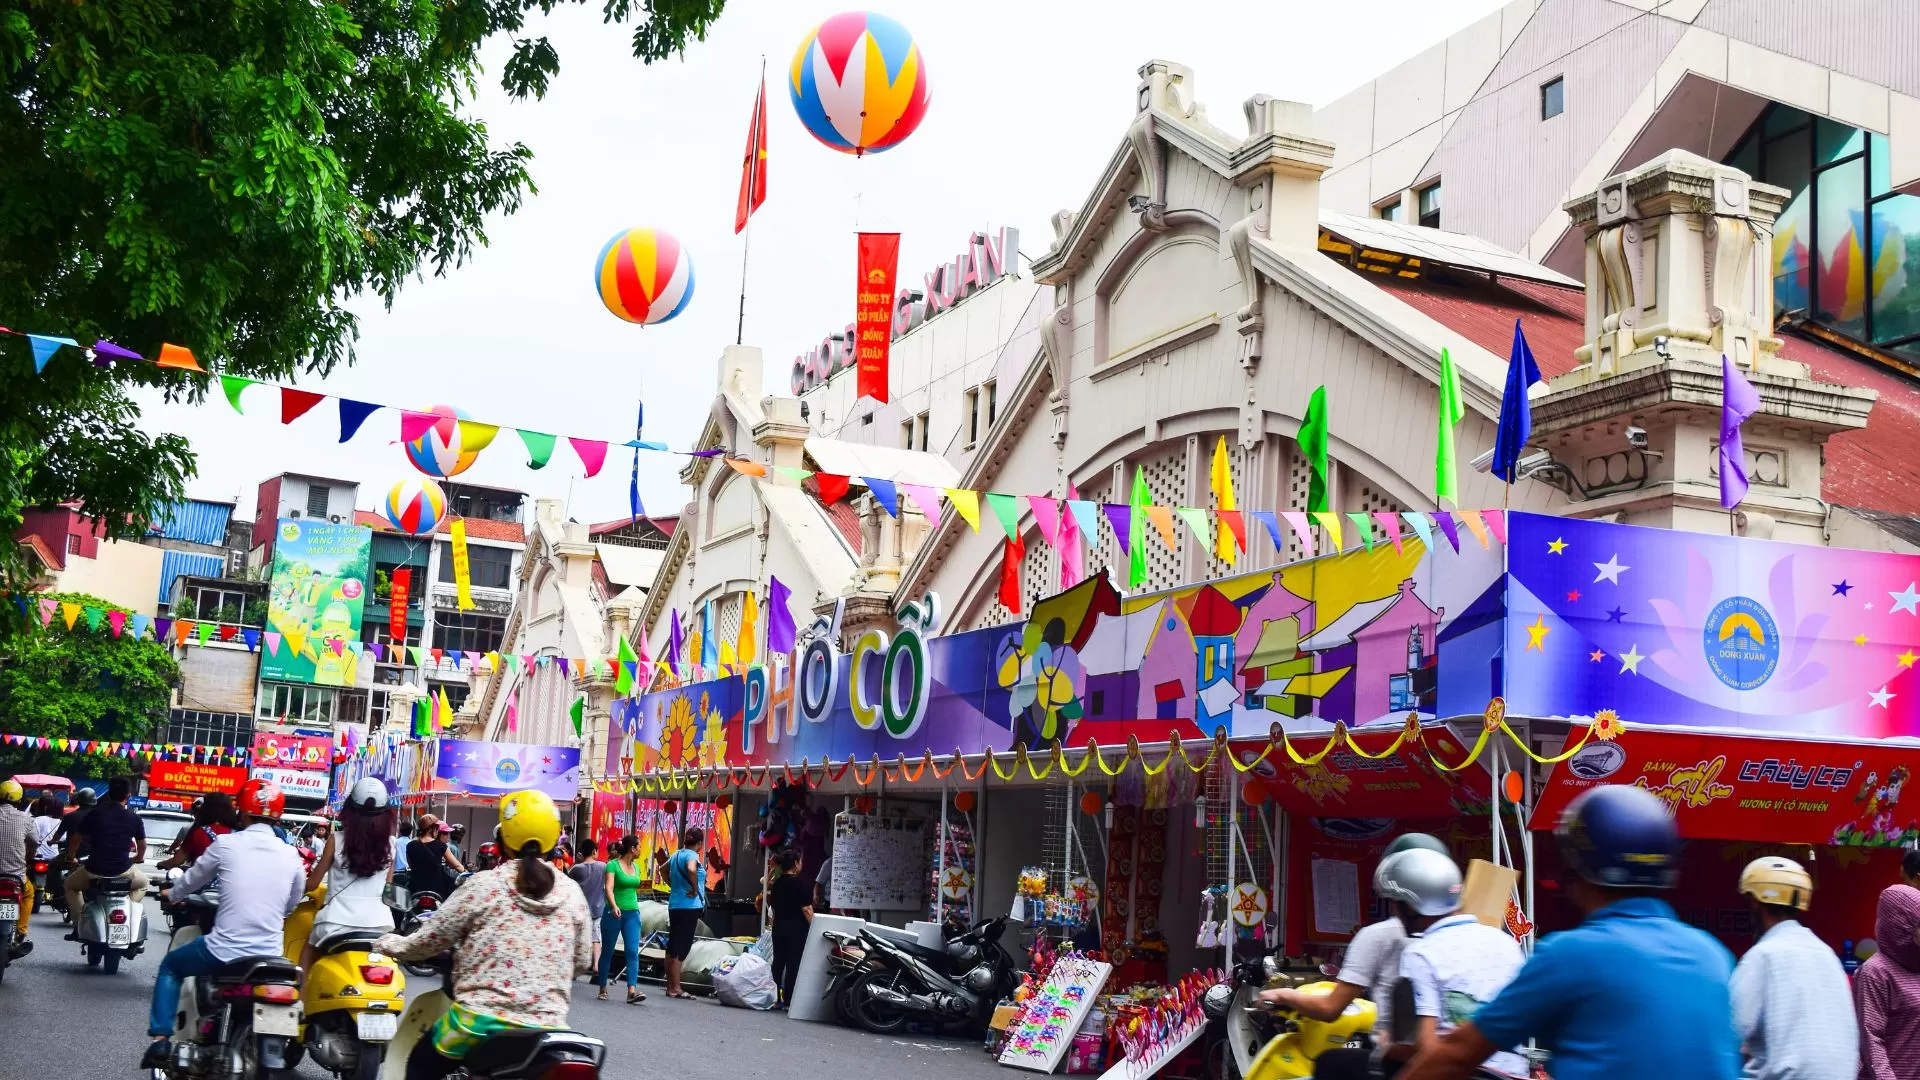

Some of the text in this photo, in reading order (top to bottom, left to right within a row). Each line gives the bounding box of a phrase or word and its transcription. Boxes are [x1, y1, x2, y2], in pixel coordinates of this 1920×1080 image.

[923, 226, 1019, 321] XUÂN
[859, 292, 891, 305] CÔNG TY
[858, 309, 868, 322] CỔ
[861, 346, 883, 359] XUÂN
[743, 591, 941, 755] PHỐ CỔ
[1643, 758, 1677, 772] BÁNH
[164, 771, 234, 787] ĐỨC THỊNH
[296, 775, 321, 787] BÍCH
[1739, 799, 1772, 809] HƯƠNG
